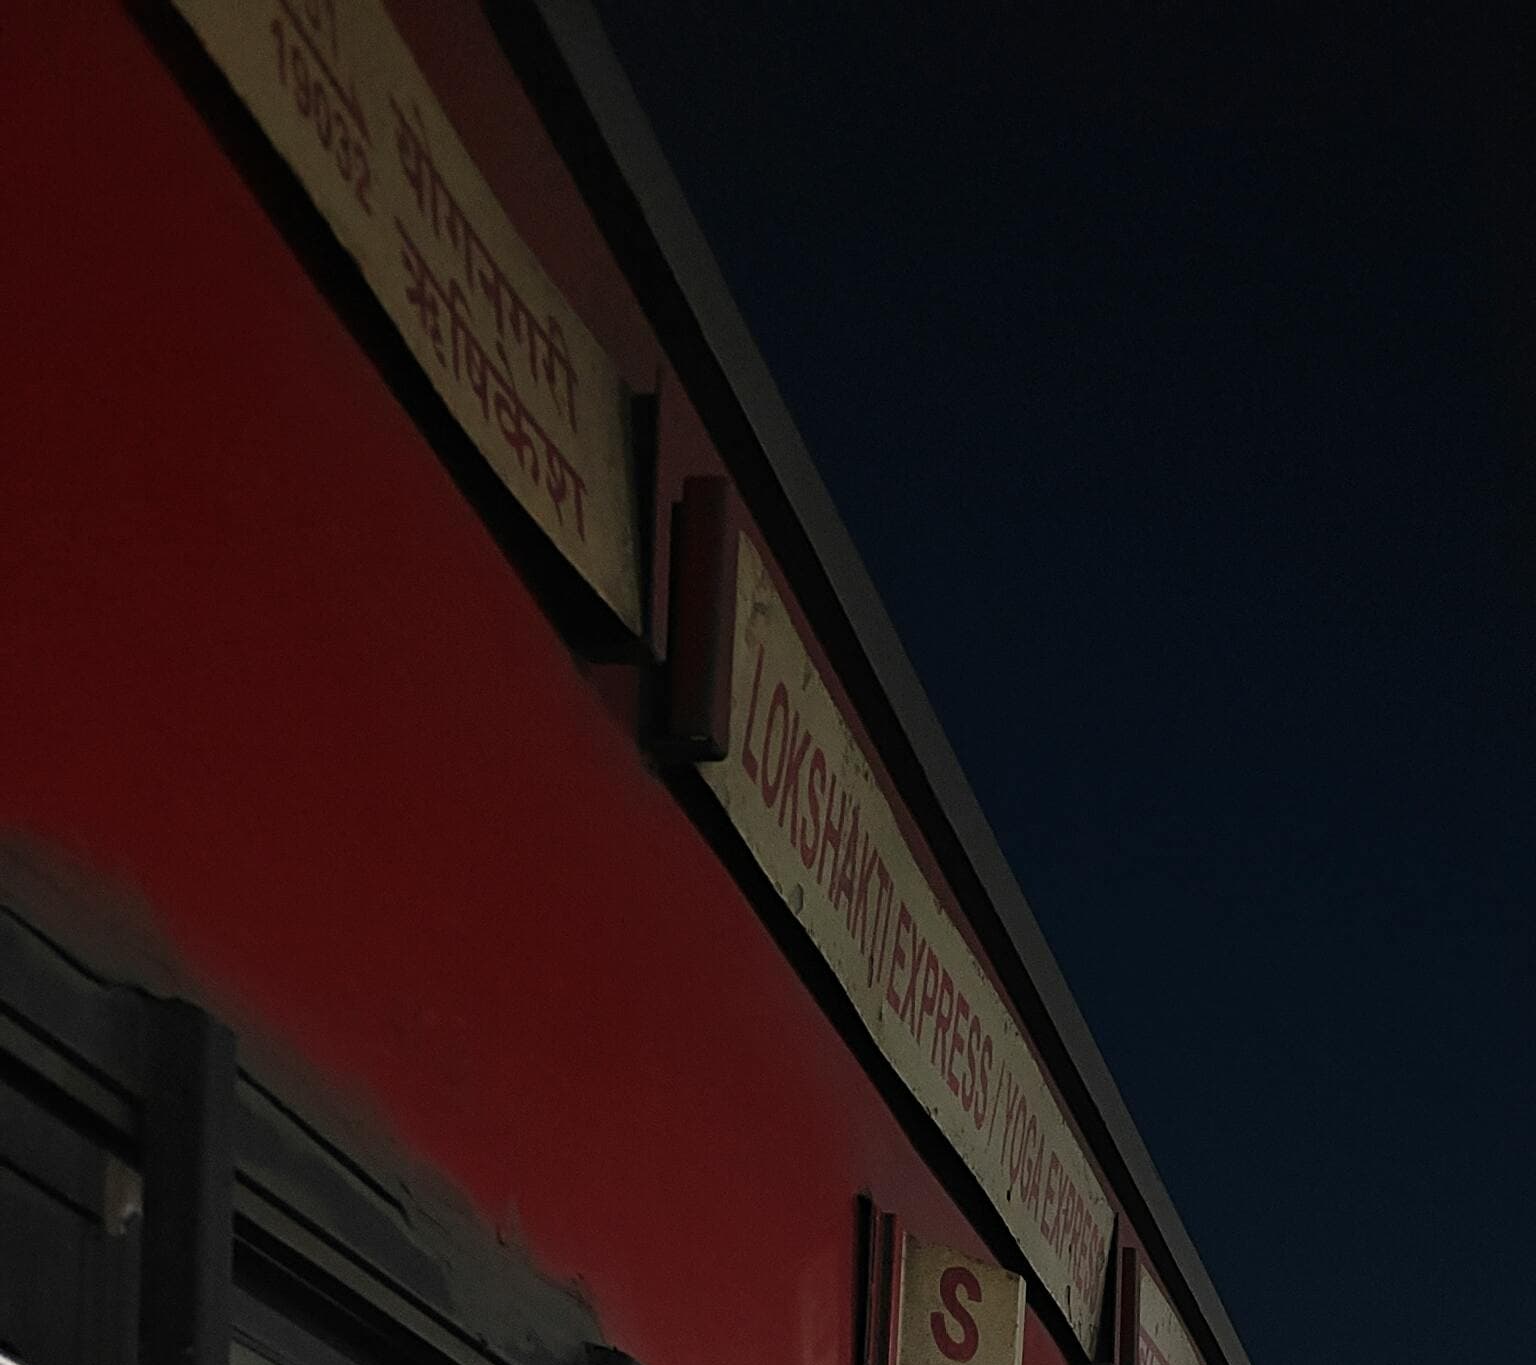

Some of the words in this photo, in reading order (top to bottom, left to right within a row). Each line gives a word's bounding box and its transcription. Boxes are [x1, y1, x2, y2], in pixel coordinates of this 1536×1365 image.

[742, 644, 893, 988] LOKSHAKTI
[886, 905, 994, 1132] EXPRESS
[1002, 1068, 1047, 1215] YOGA
[1040, 1142, 1107, 1300] EXPRESS
[930, 1265, 983, 1363] S
